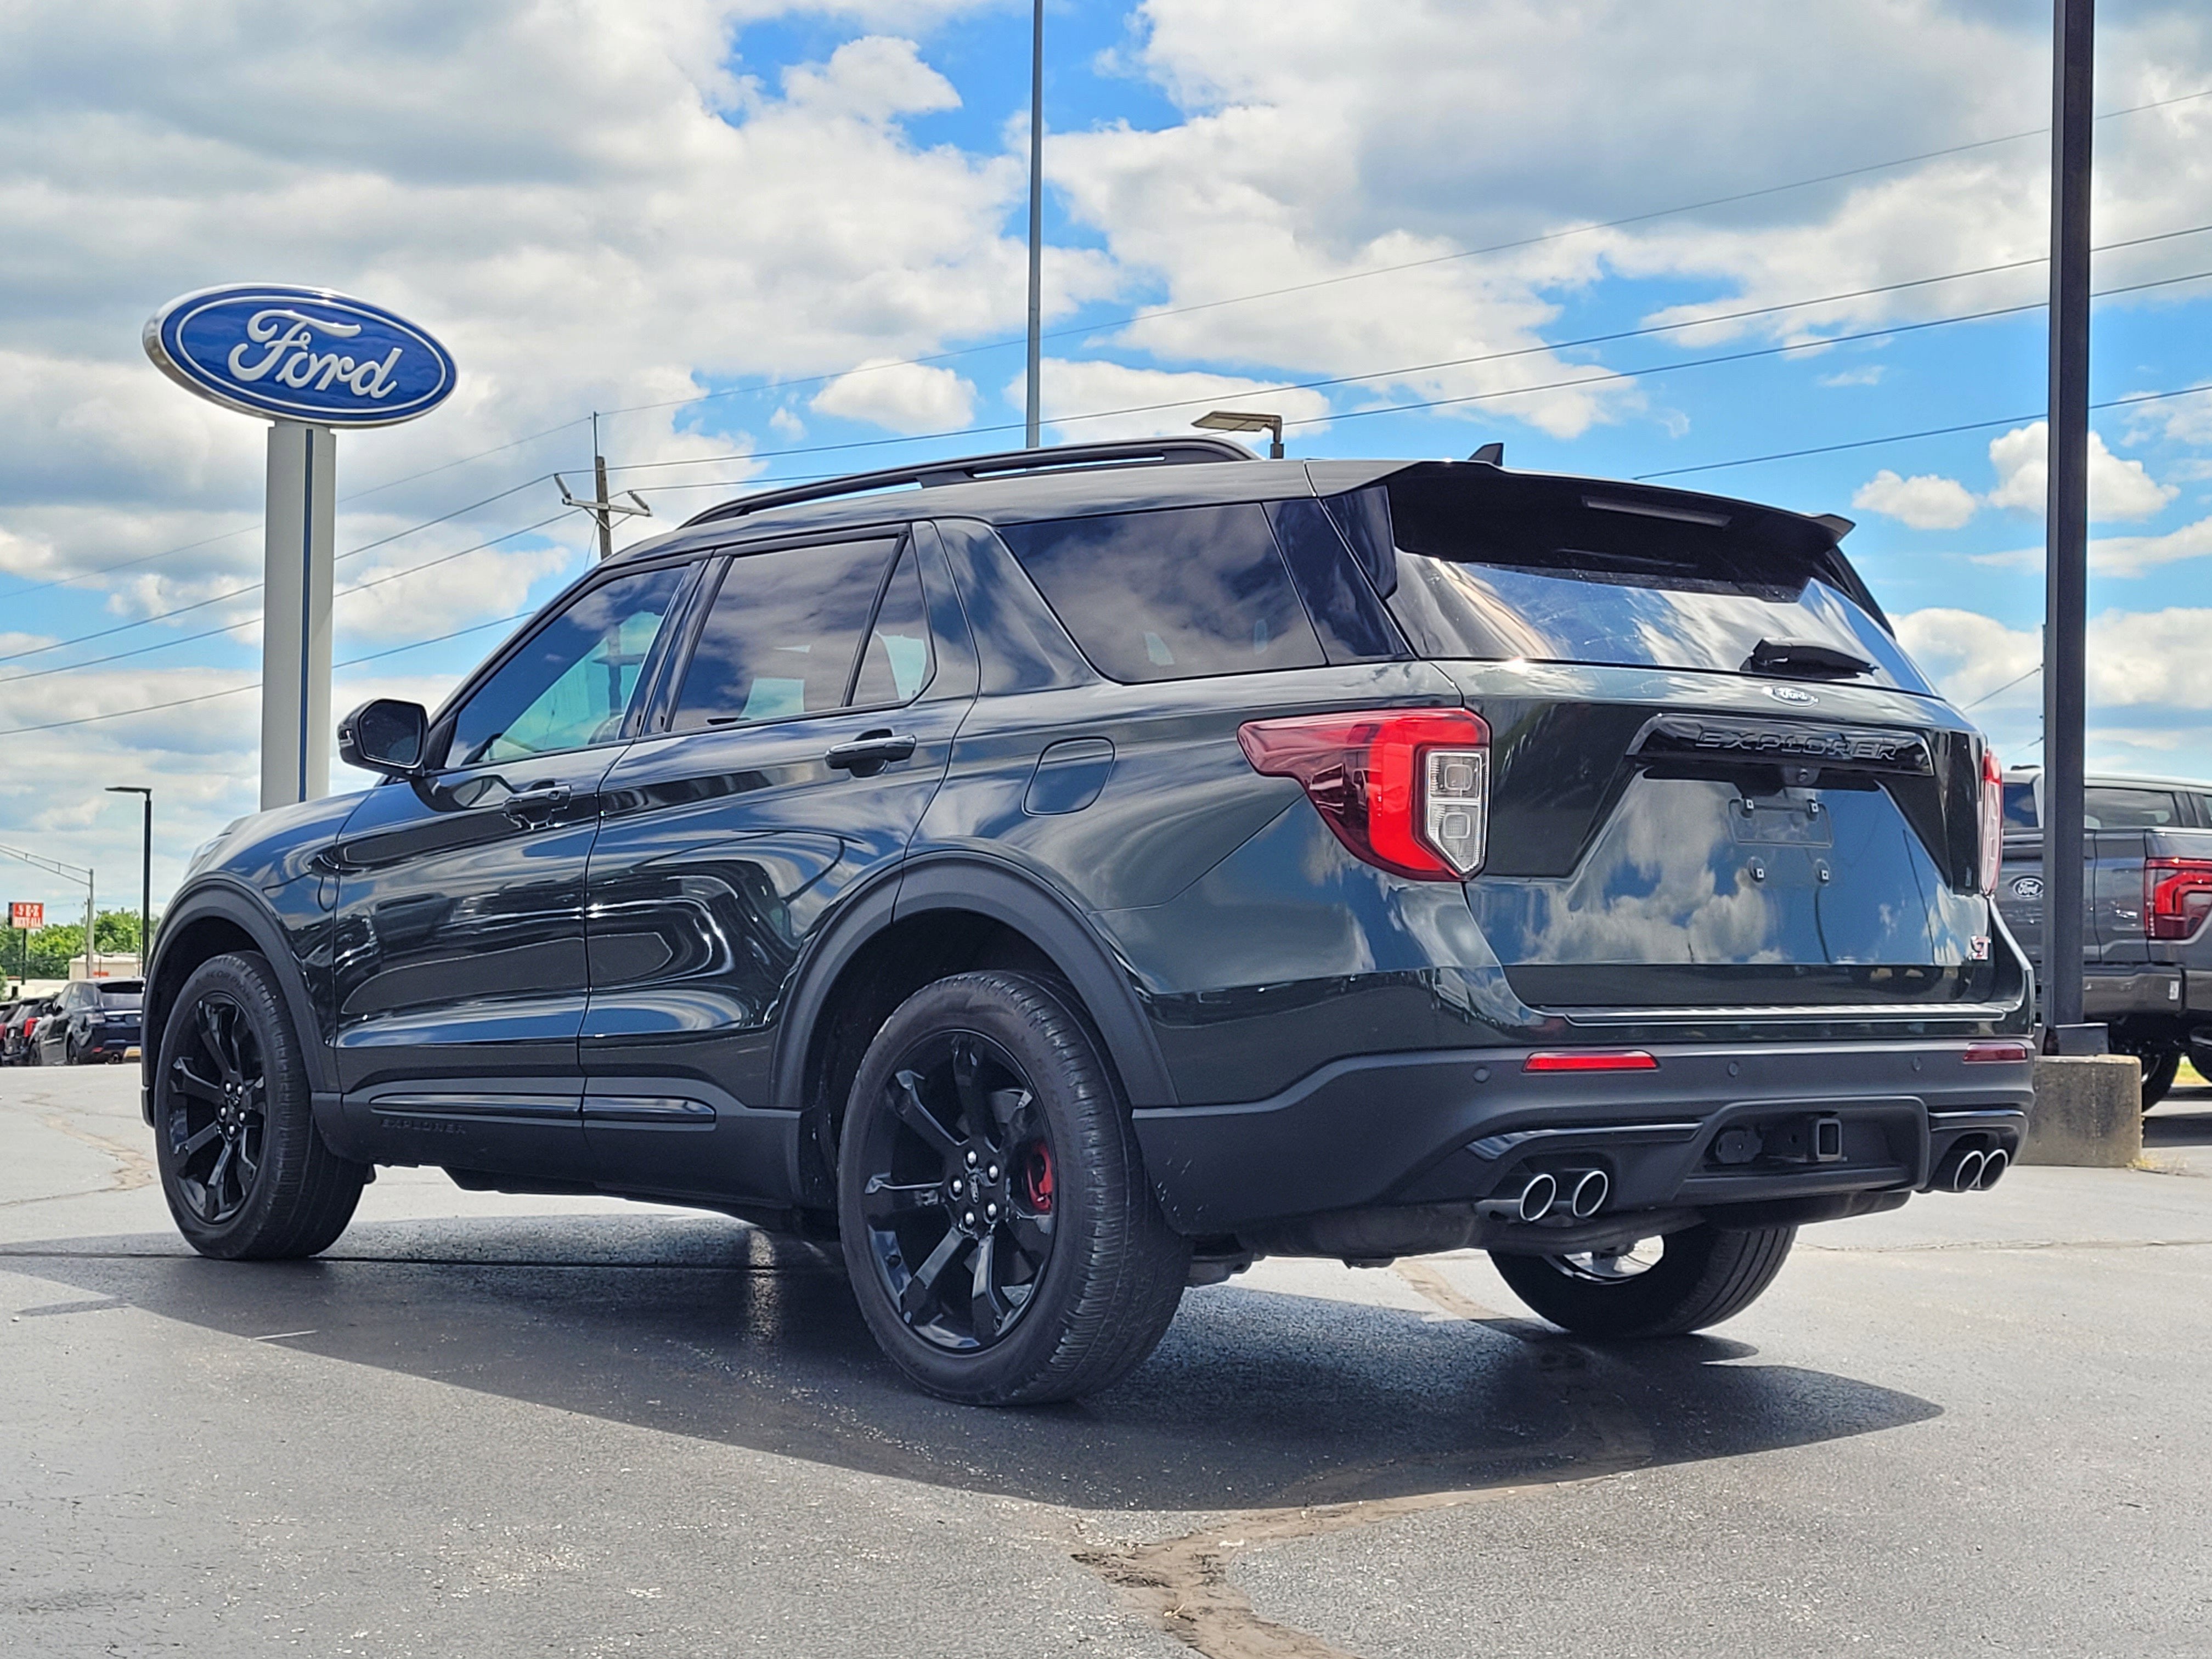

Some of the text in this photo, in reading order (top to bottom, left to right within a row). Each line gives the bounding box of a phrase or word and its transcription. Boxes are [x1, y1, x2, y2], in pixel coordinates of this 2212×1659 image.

[228, 309, 403, 399] Ford
[1695, 729, 1897, 761] EXPLORER
[2018, 881, 2039, 895] Ford
[380, 1118, 466, 1135] EXPLORER
